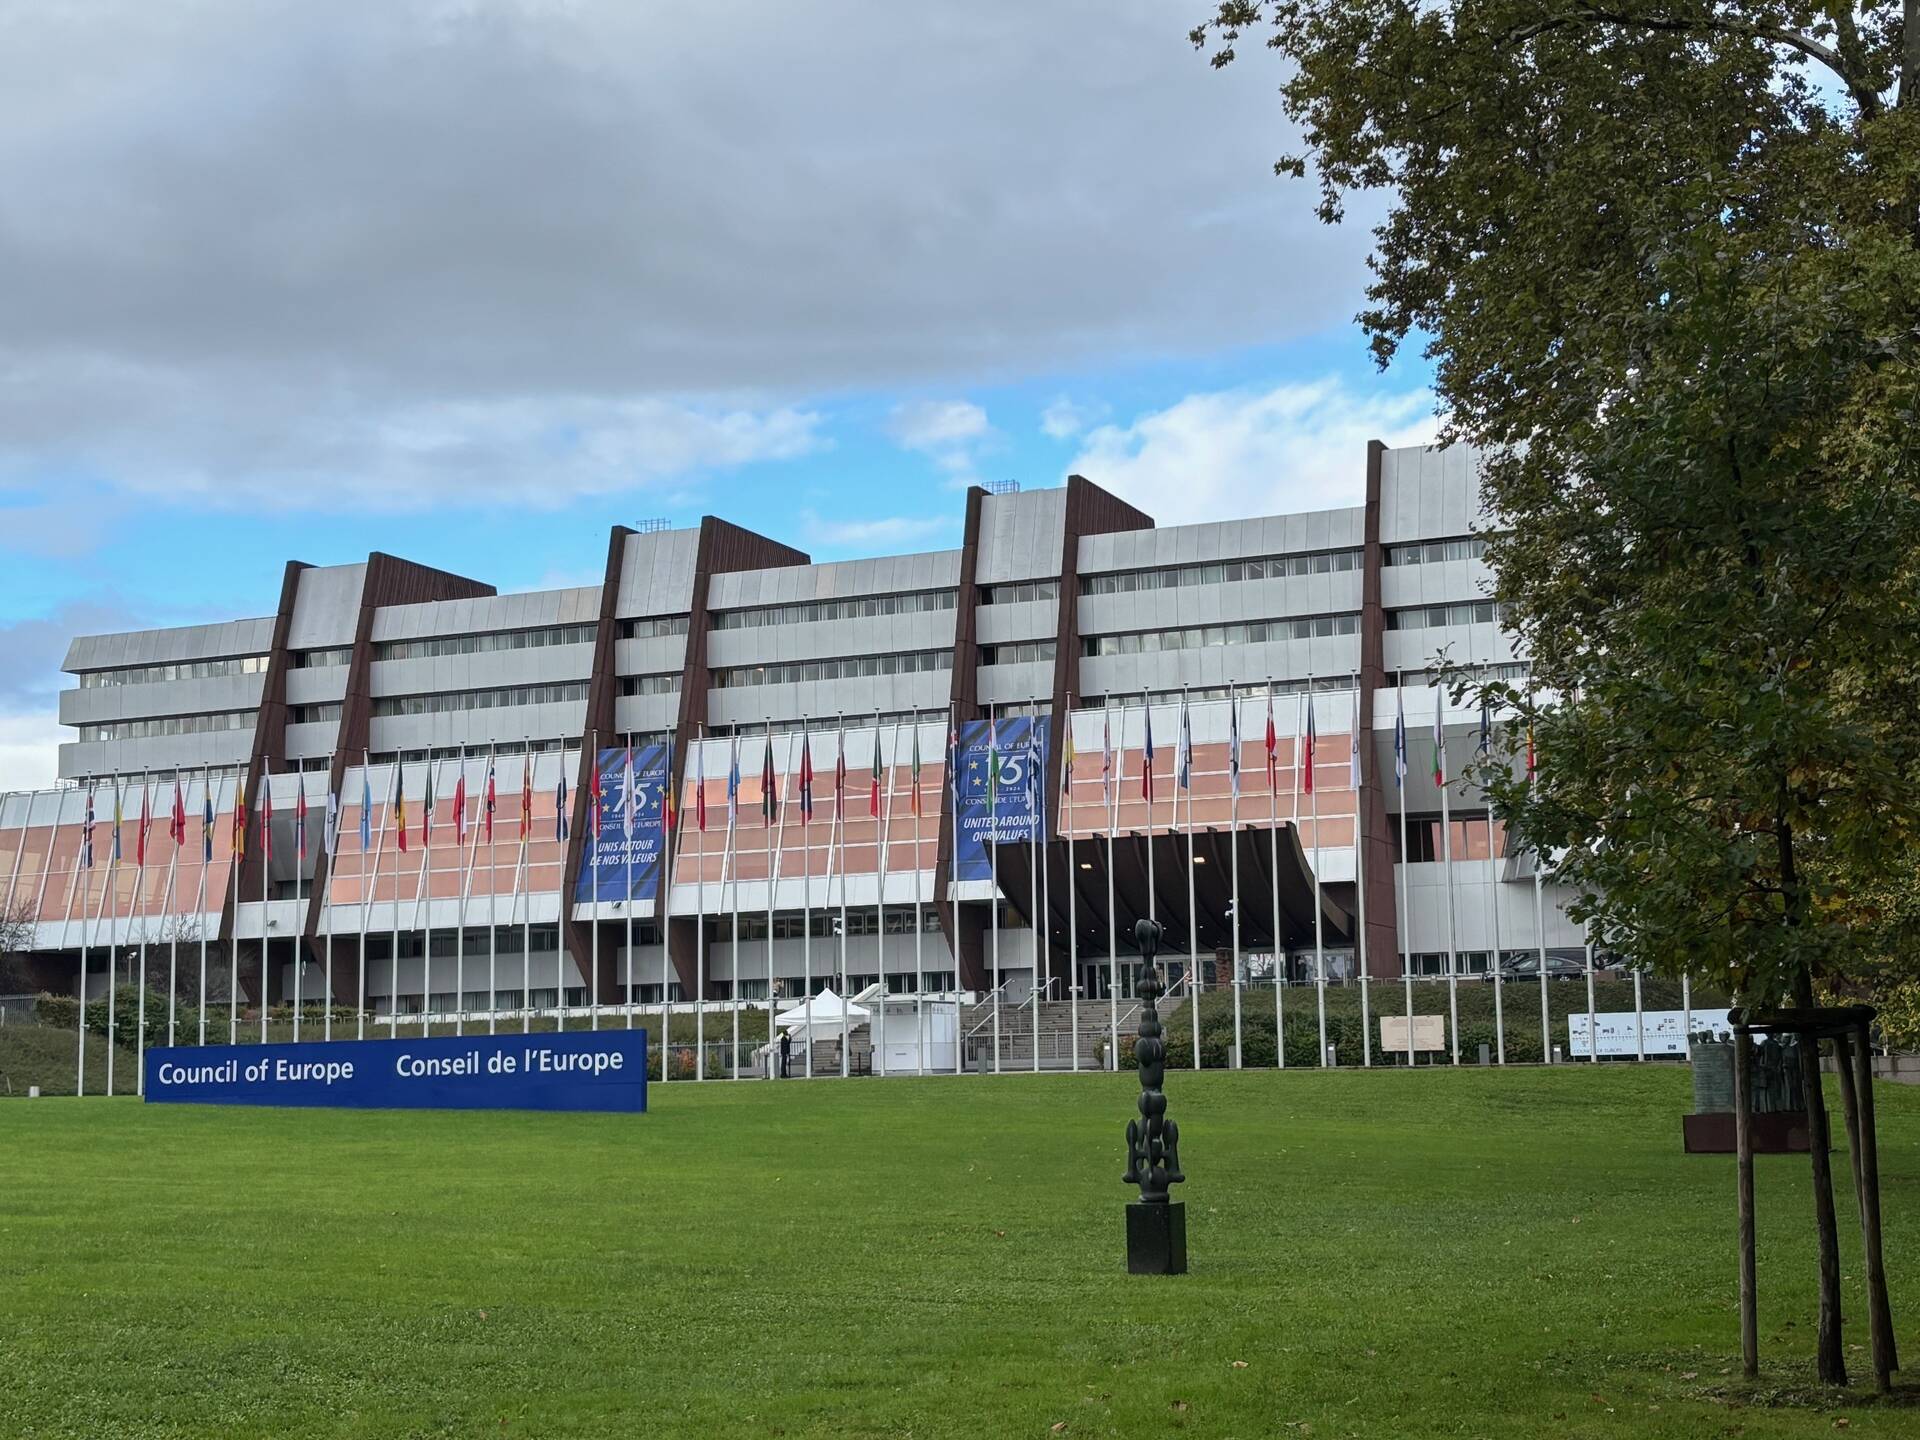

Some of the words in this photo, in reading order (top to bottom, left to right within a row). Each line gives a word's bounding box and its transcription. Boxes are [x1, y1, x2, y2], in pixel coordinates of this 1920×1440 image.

[964, 816, 998, 829] UNITED
[999, 814, 1040, 827] AROUND
[972, 831, 993, 842] OUR
[598, 841, 619, 853] UNIS
[602, 854, 620, 866] NOS
[396, 1051, 479, 1077] Conseil
[487, 1050, 517, 1074] de
[525, 1048, 624, 1076] l'Europe
[159, 1060, 238, 1085] Council
[244, 1058, 269, 1082] of
[276, 1059, 354, 1085] Europe
